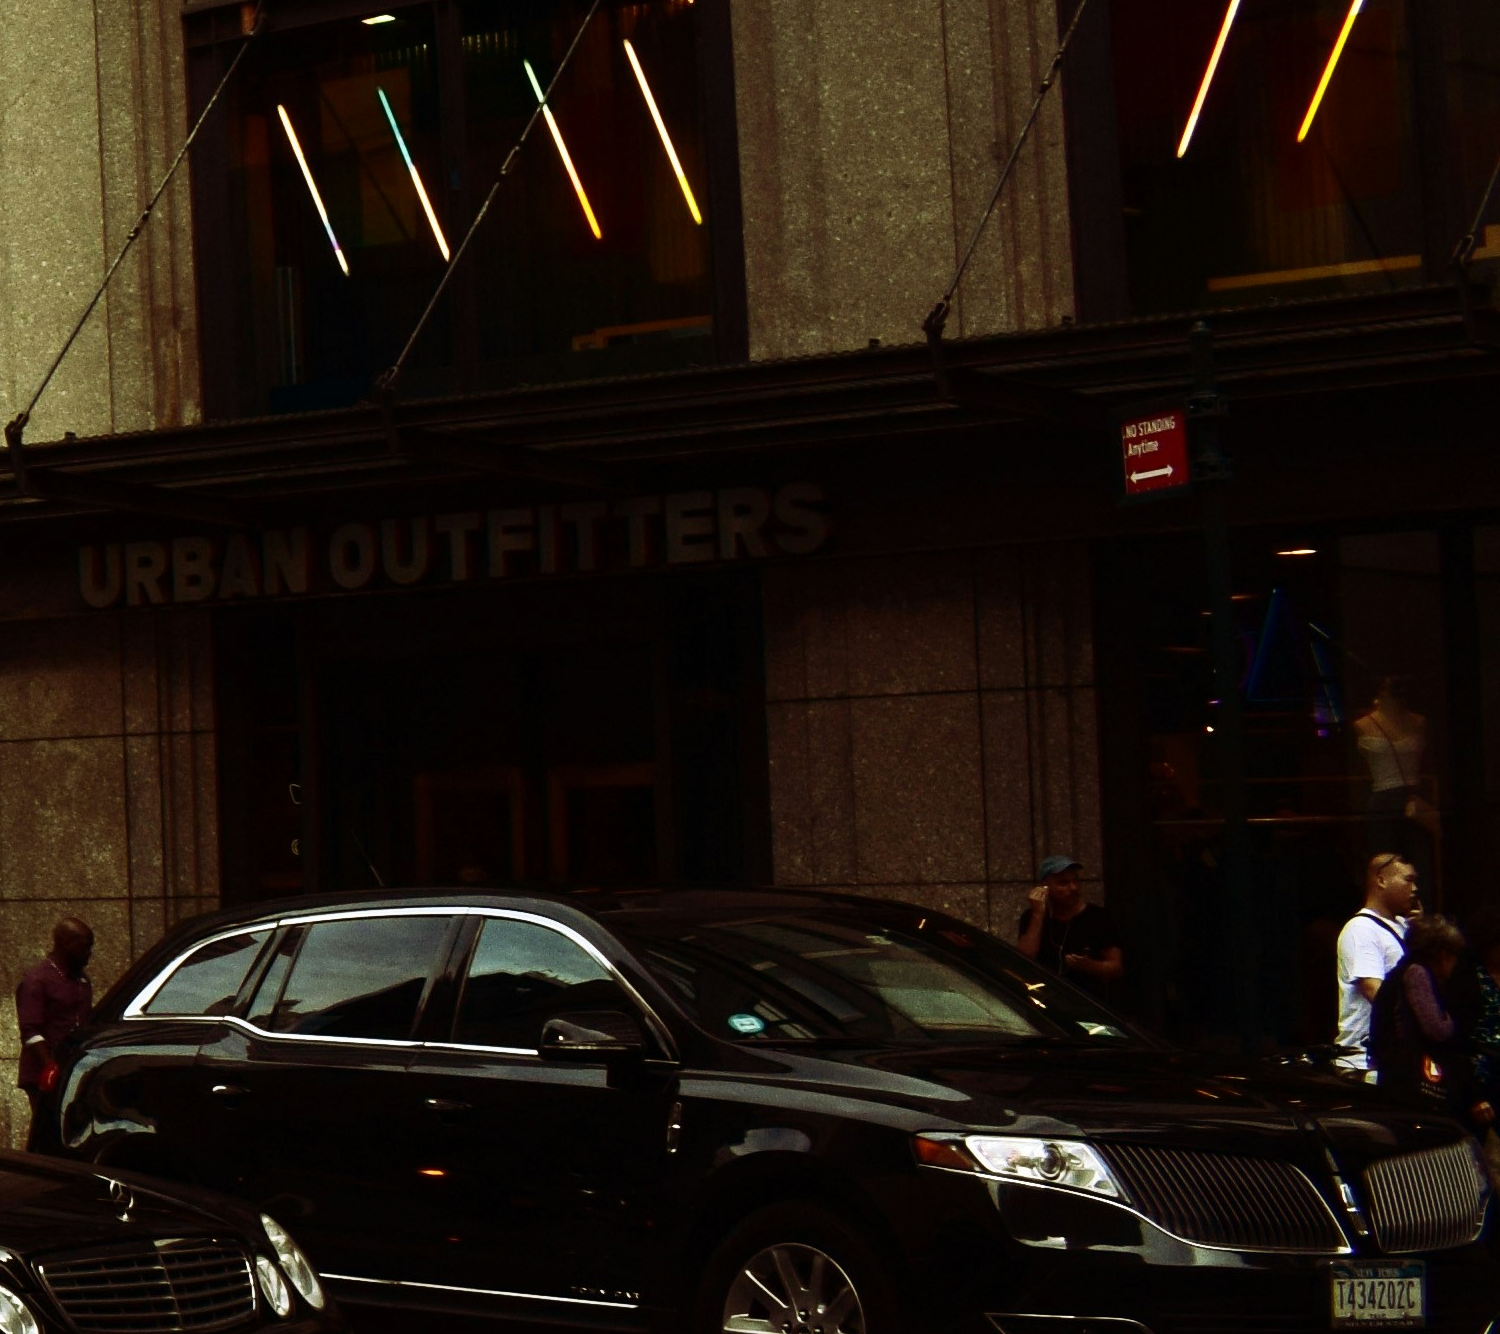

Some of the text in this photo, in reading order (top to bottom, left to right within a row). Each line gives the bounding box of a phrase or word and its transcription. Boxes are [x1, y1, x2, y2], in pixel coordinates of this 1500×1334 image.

[1125, 416, 1176, 438] NO STANDING
[77, 481, 829, 609] URBAN OUTFITTERS
[1337, 1280, 1416, 1309] T434202C
